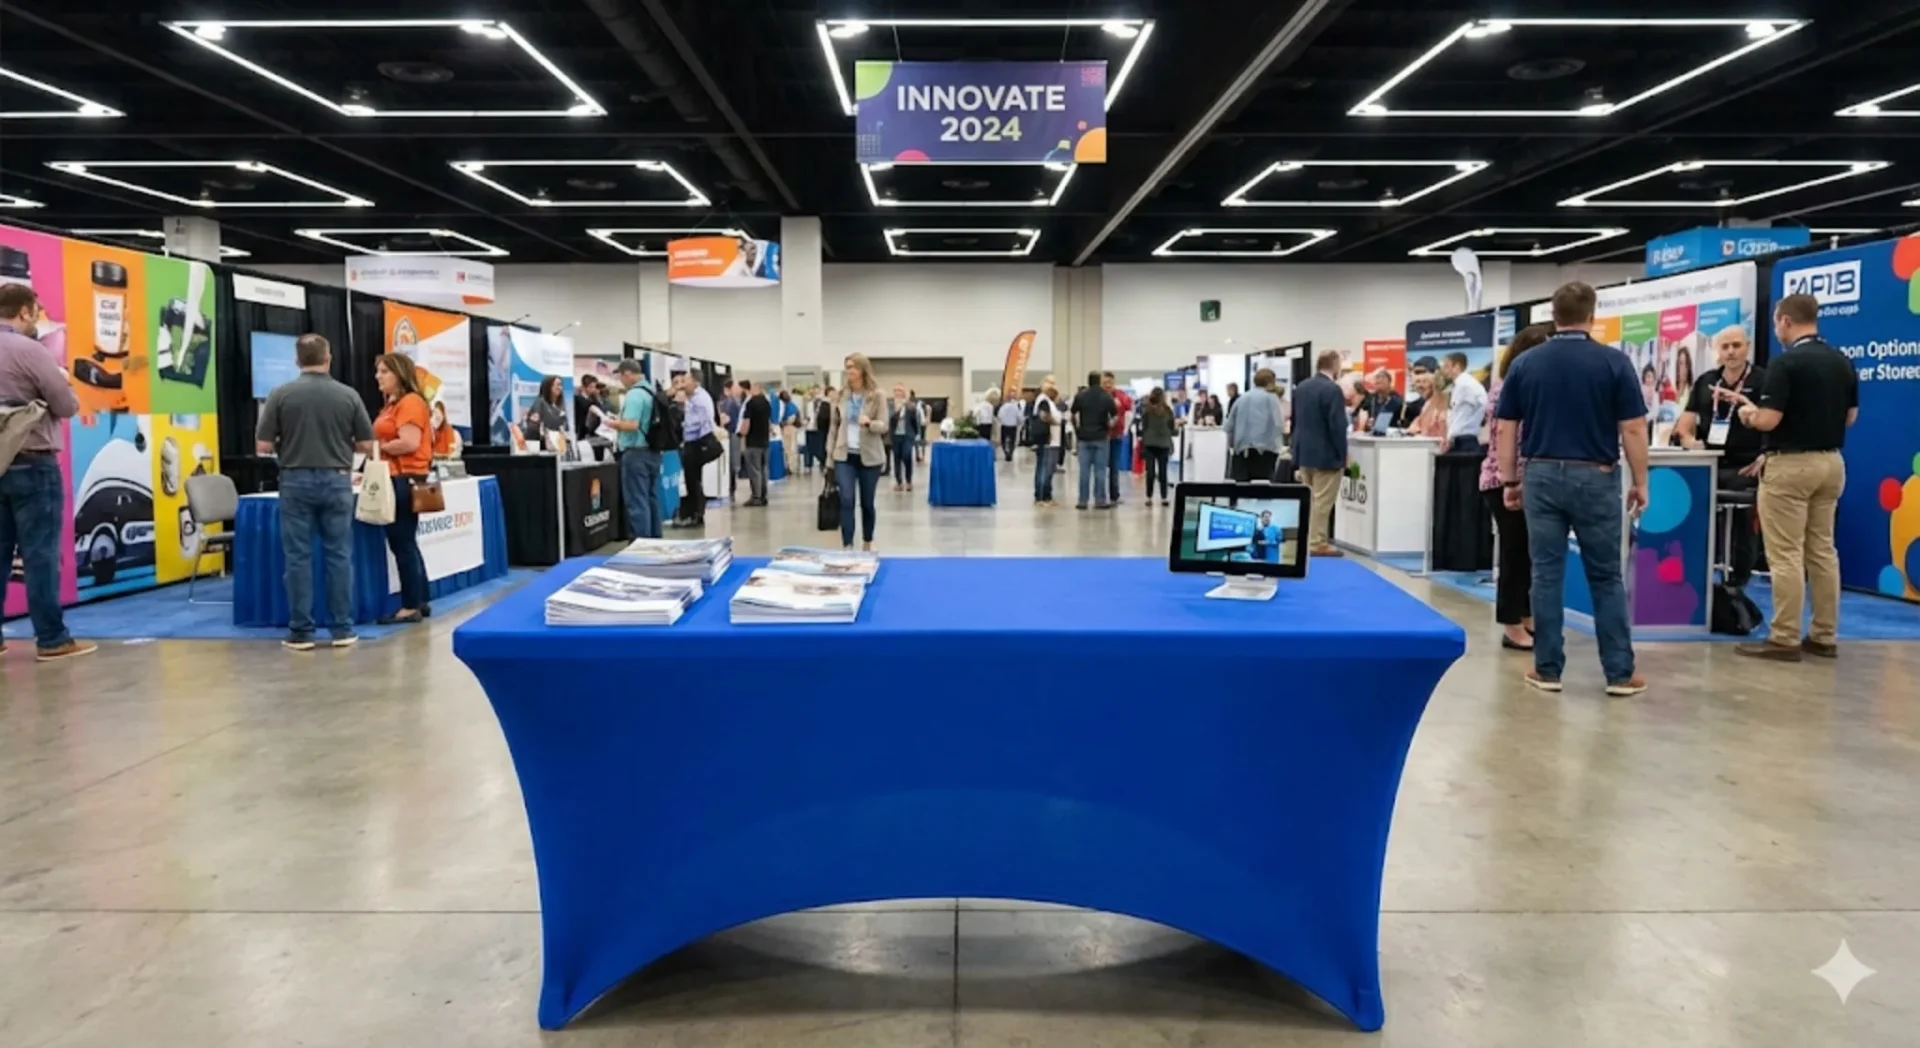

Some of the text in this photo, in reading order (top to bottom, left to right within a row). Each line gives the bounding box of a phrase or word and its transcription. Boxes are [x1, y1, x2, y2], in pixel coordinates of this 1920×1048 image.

[897, 85, 1066, 111] INNOVATE
[940, 116, 1022, 142] 2024
[1856, 366, 1875, 381] er
